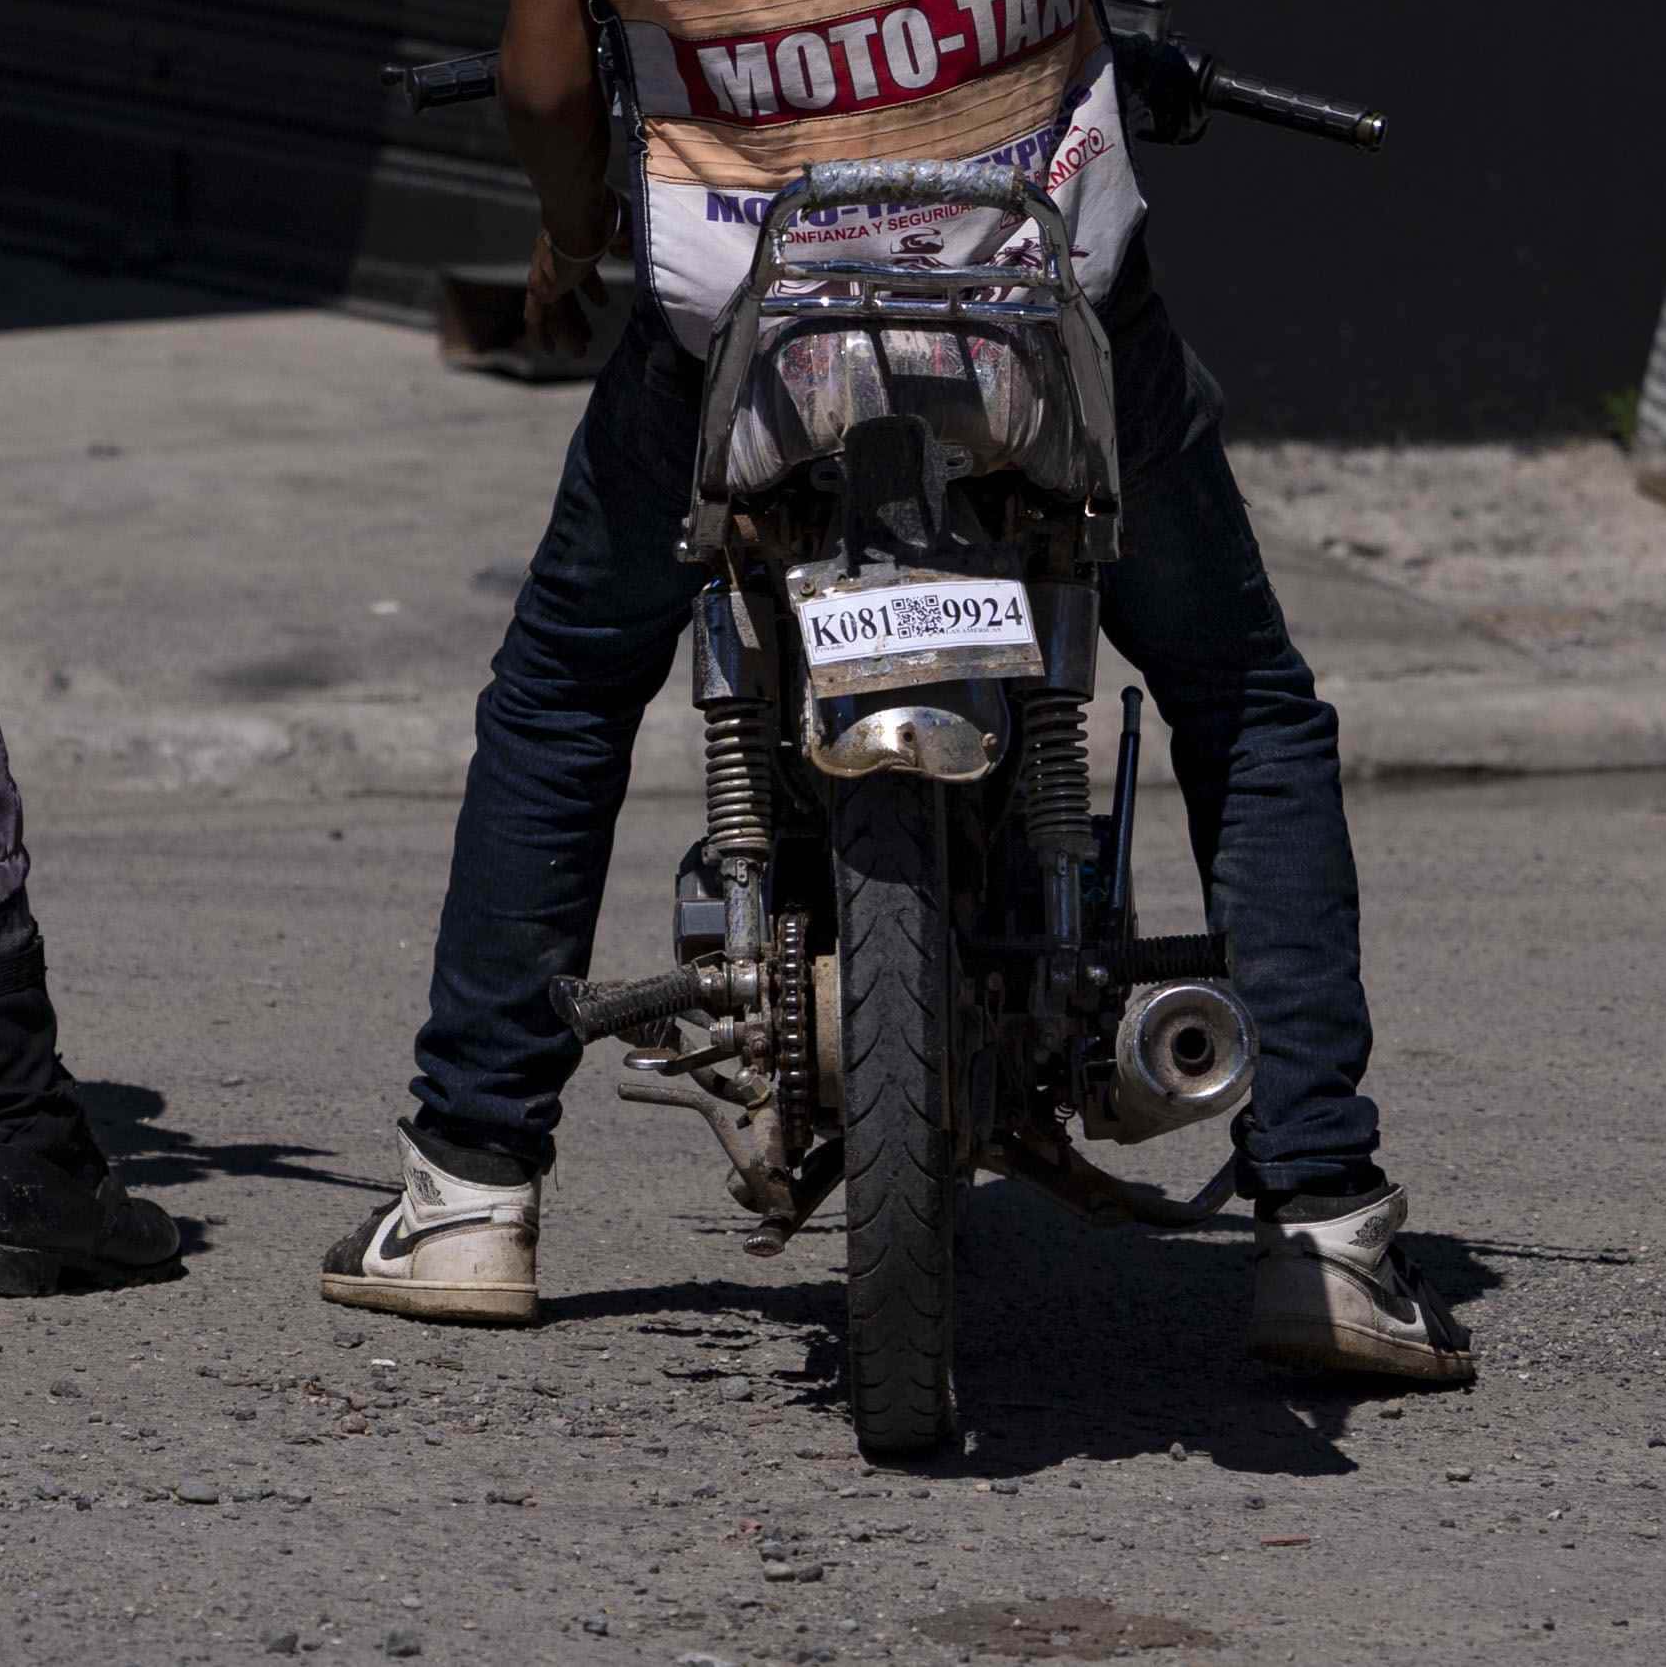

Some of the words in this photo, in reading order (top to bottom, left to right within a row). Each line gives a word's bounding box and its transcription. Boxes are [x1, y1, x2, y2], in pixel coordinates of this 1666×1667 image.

[784, 225, 869, 244] ONFIANZA
[872, 221, 883, 234] Y
[810, 605, 895, 648] K081
[941, 596, 1024, 630] 9924
